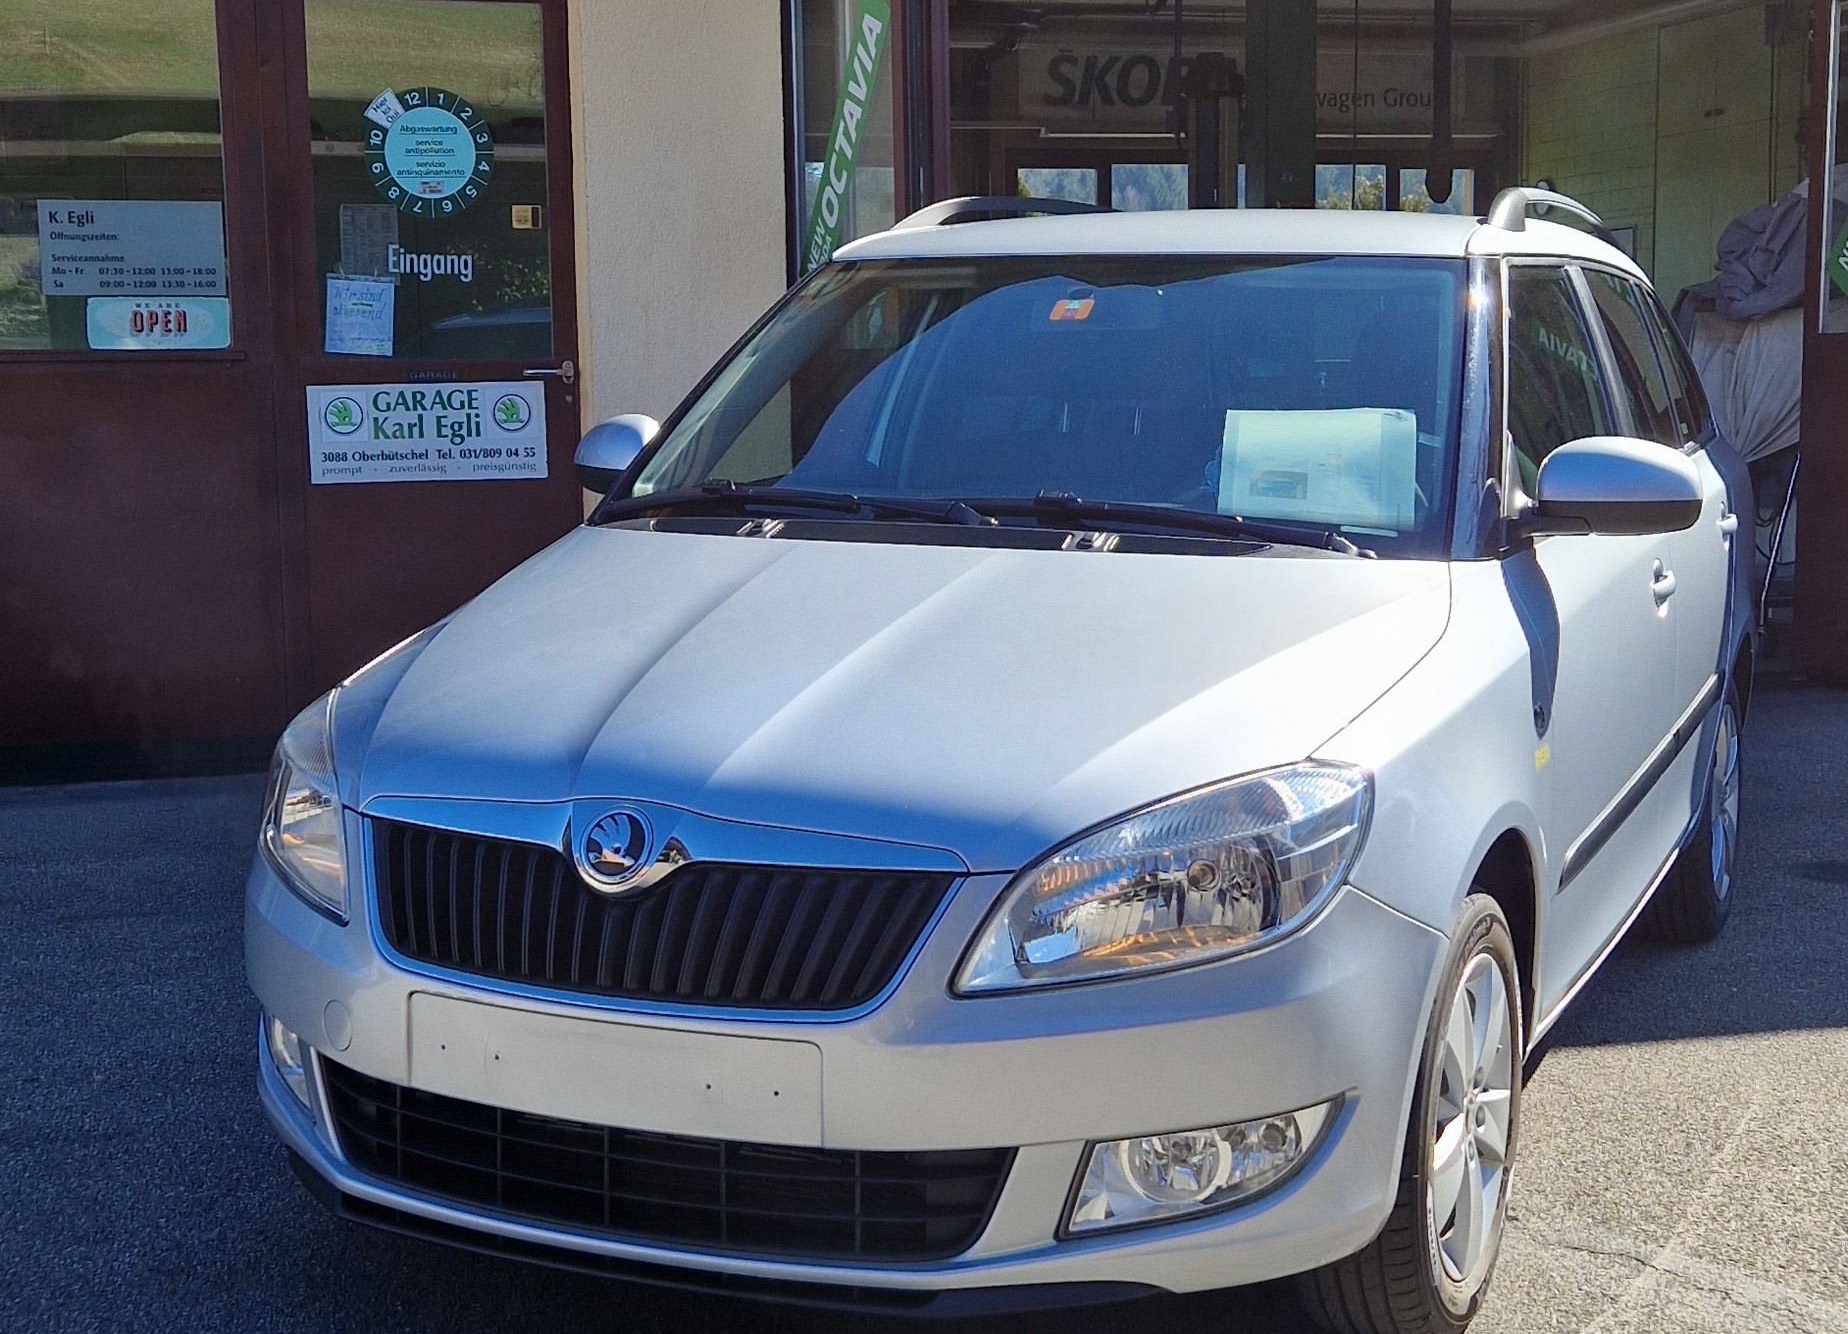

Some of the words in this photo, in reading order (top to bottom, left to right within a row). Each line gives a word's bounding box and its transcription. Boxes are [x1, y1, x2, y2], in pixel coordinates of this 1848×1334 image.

[1043, 49, 1238, 106] ŠKO
[404, 91, 421, 106] 12
[437, 93, 445, 105] 1
[1383, 87, 1432, 107] Grou
[460, 107, 473, 120] 2
[821, 12, 883, 229] OCTAVIA
[369, 129, 384, 146] 10
[476, 132, 489, 143] 3
[477, 161, 490, 171] 4
[388, 186, 400, 199] 8
[465, 185, 478, 198] 5
[413, 200, 423, 213] 7
[48, 211, 64, 224] K.
[67, 210, 95, 227] Egli
[51, 254, 125, 263] Serviceannahme
[387, 243, 473, 282] Eingang
[53, 279, 64, 288] Sa
[357, 287, 386, 303] sind
[130, 309, 188, 334] OPEN
[372, 389, 479, 413] GARAGE
[372, 413, 425, 440] Karl
[436, 412, 481, 445] Egli
[321, 452, 348, 463] 3088
[352, 449, 429, 462] Oberbütschel
[436, 449, 456, 460] Tel.
[459, 447, 502, 460] 031/809
[506, 447, 520, 458] 04
[523, 447, 536, 458] 55
[321, 465, 362, 477] prompt
[388, 463, 447, 474] zuverlässig
[472, 461, 537, 474] preisgünstig
